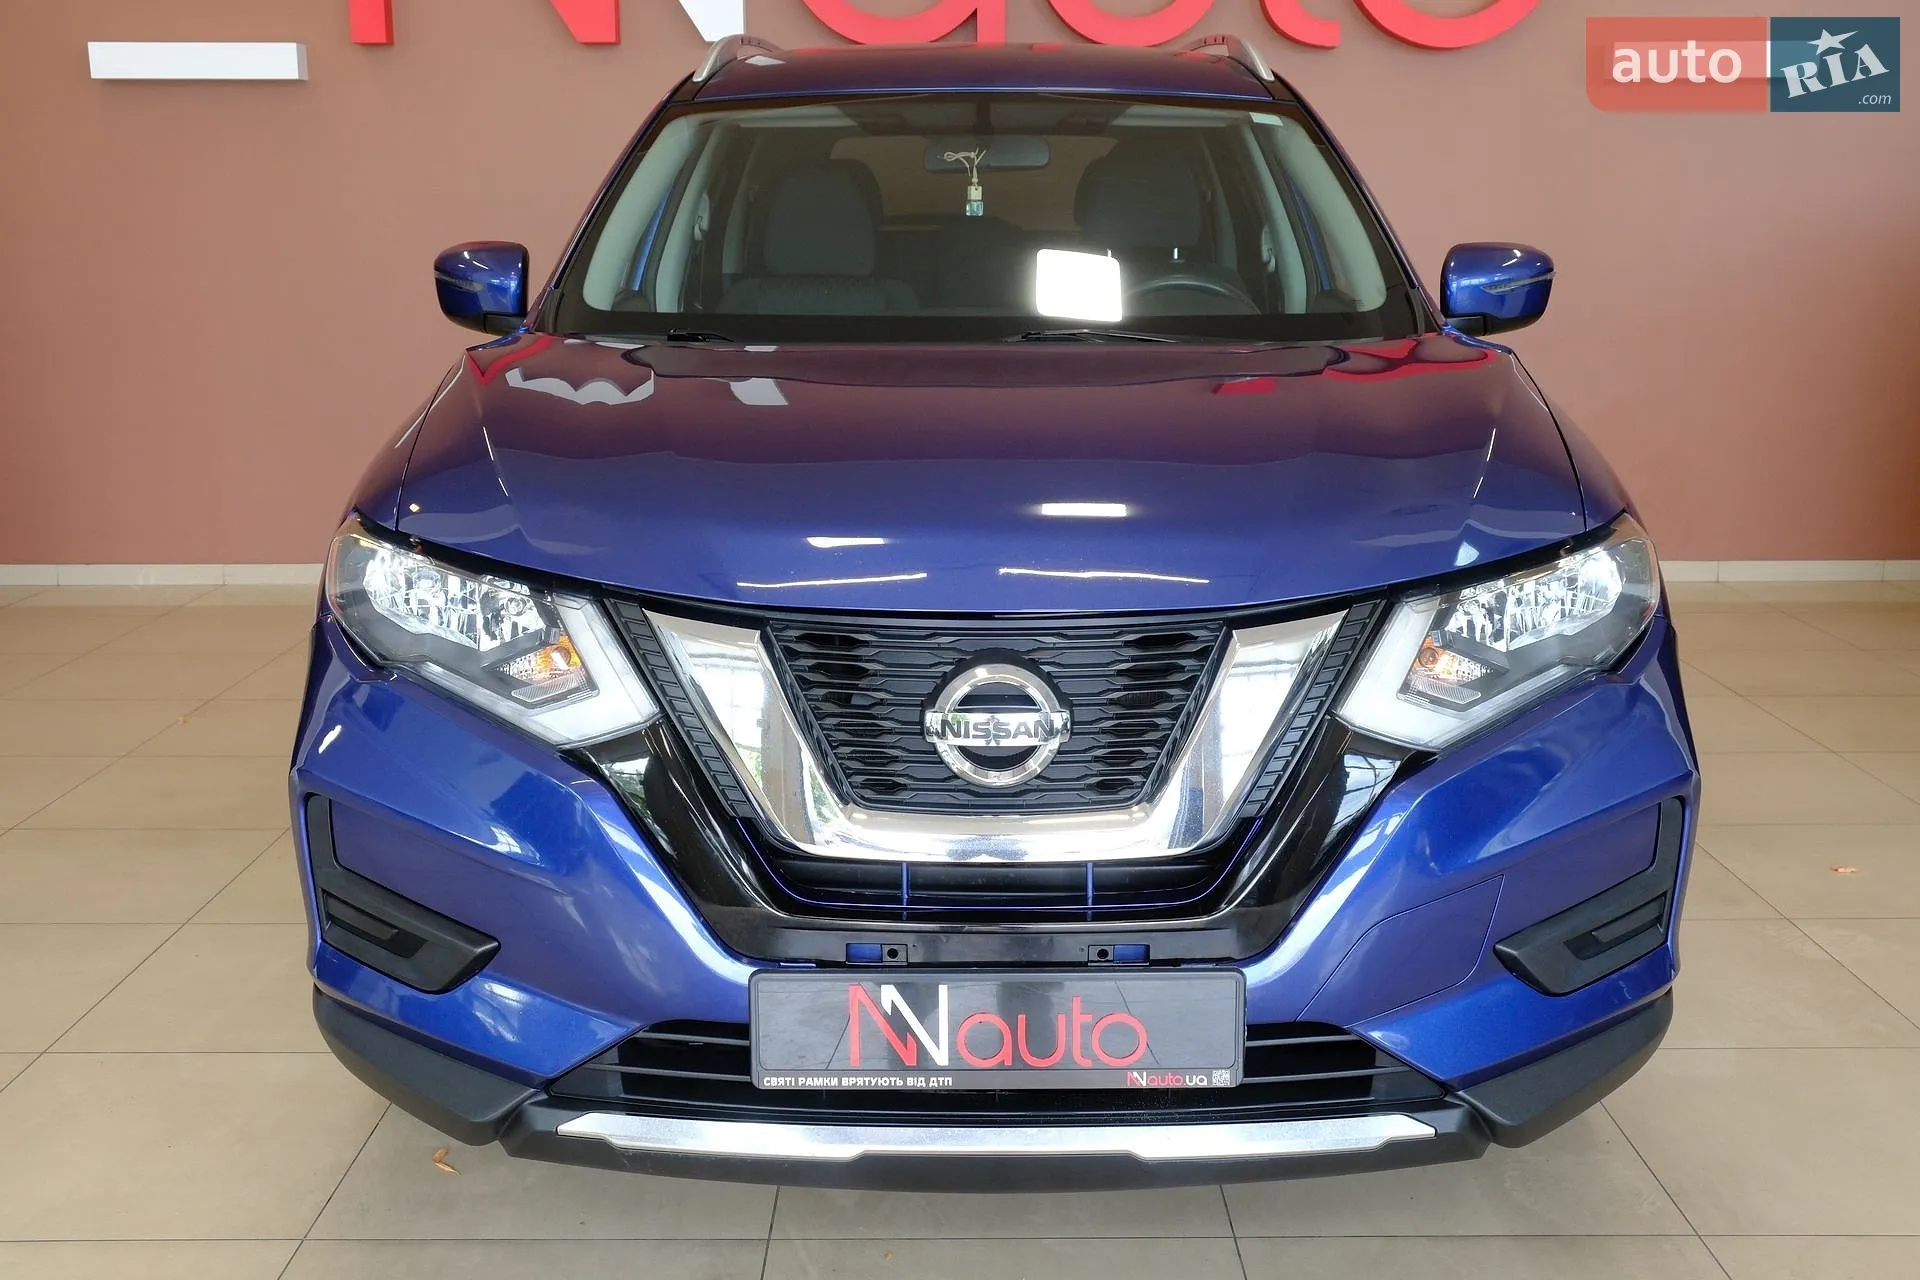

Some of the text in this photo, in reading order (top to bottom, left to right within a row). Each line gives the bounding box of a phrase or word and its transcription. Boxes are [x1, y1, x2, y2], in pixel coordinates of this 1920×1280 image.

[940, 719, 1055, 740] NISSAN
[763, 1076, 795, 1087] СВЯТІ
[798, 1076, 838, 1087] РАМКИ
[841, 1076, 904, 1087] ВРЯТУЮТЬ
[928, 1076, 953, 1088] ДТП
